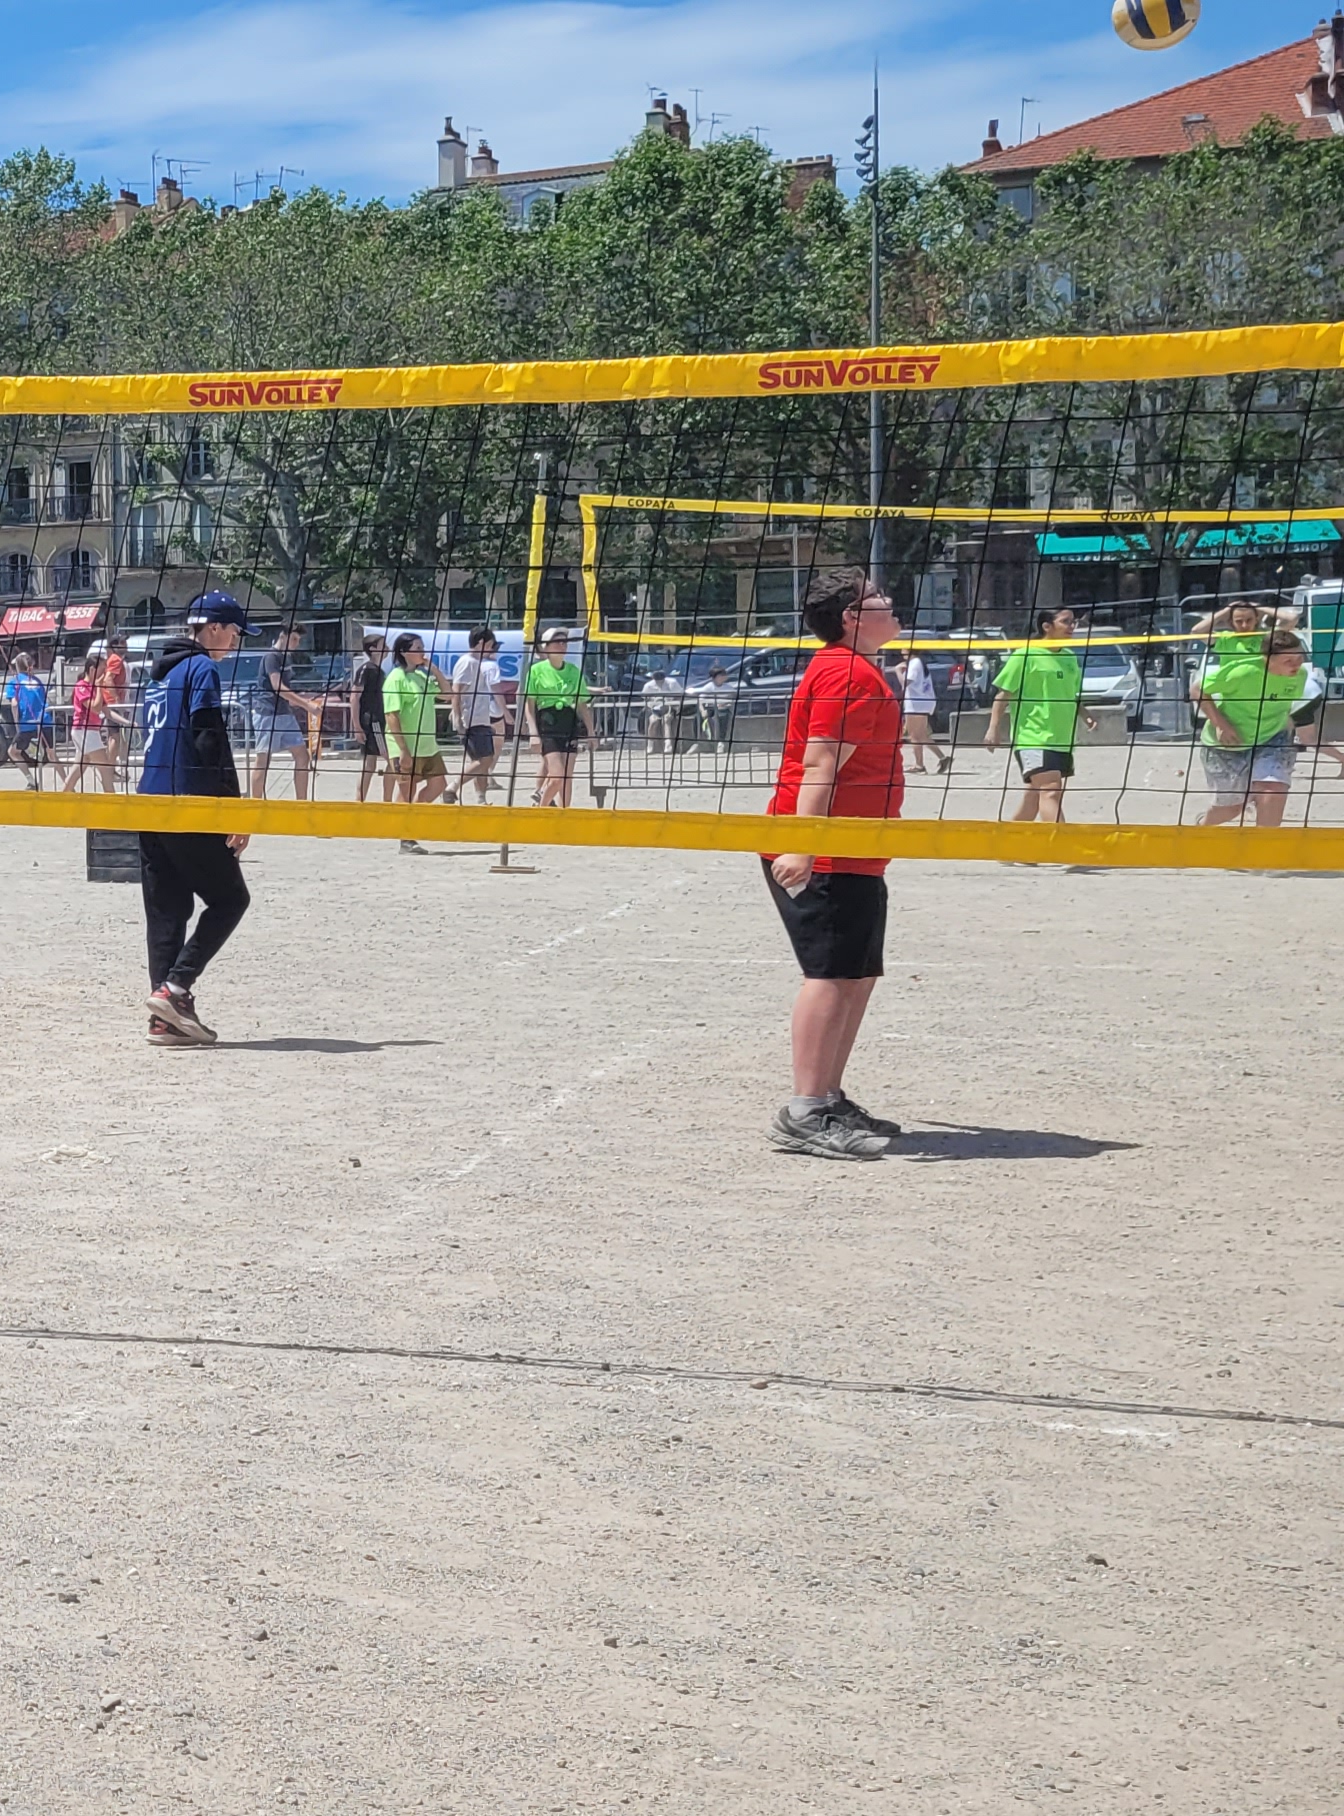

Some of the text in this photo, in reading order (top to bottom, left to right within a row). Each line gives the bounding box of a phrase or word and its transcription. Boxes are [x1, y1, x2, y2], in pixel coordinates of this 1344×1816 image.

[854, 507, 905, 518] COPAYA
[1100, 511, 1155, 522] COPAYA
[1293, 542, 1329, 552] SHOP
[8, 608, 46, 623] TABAC
